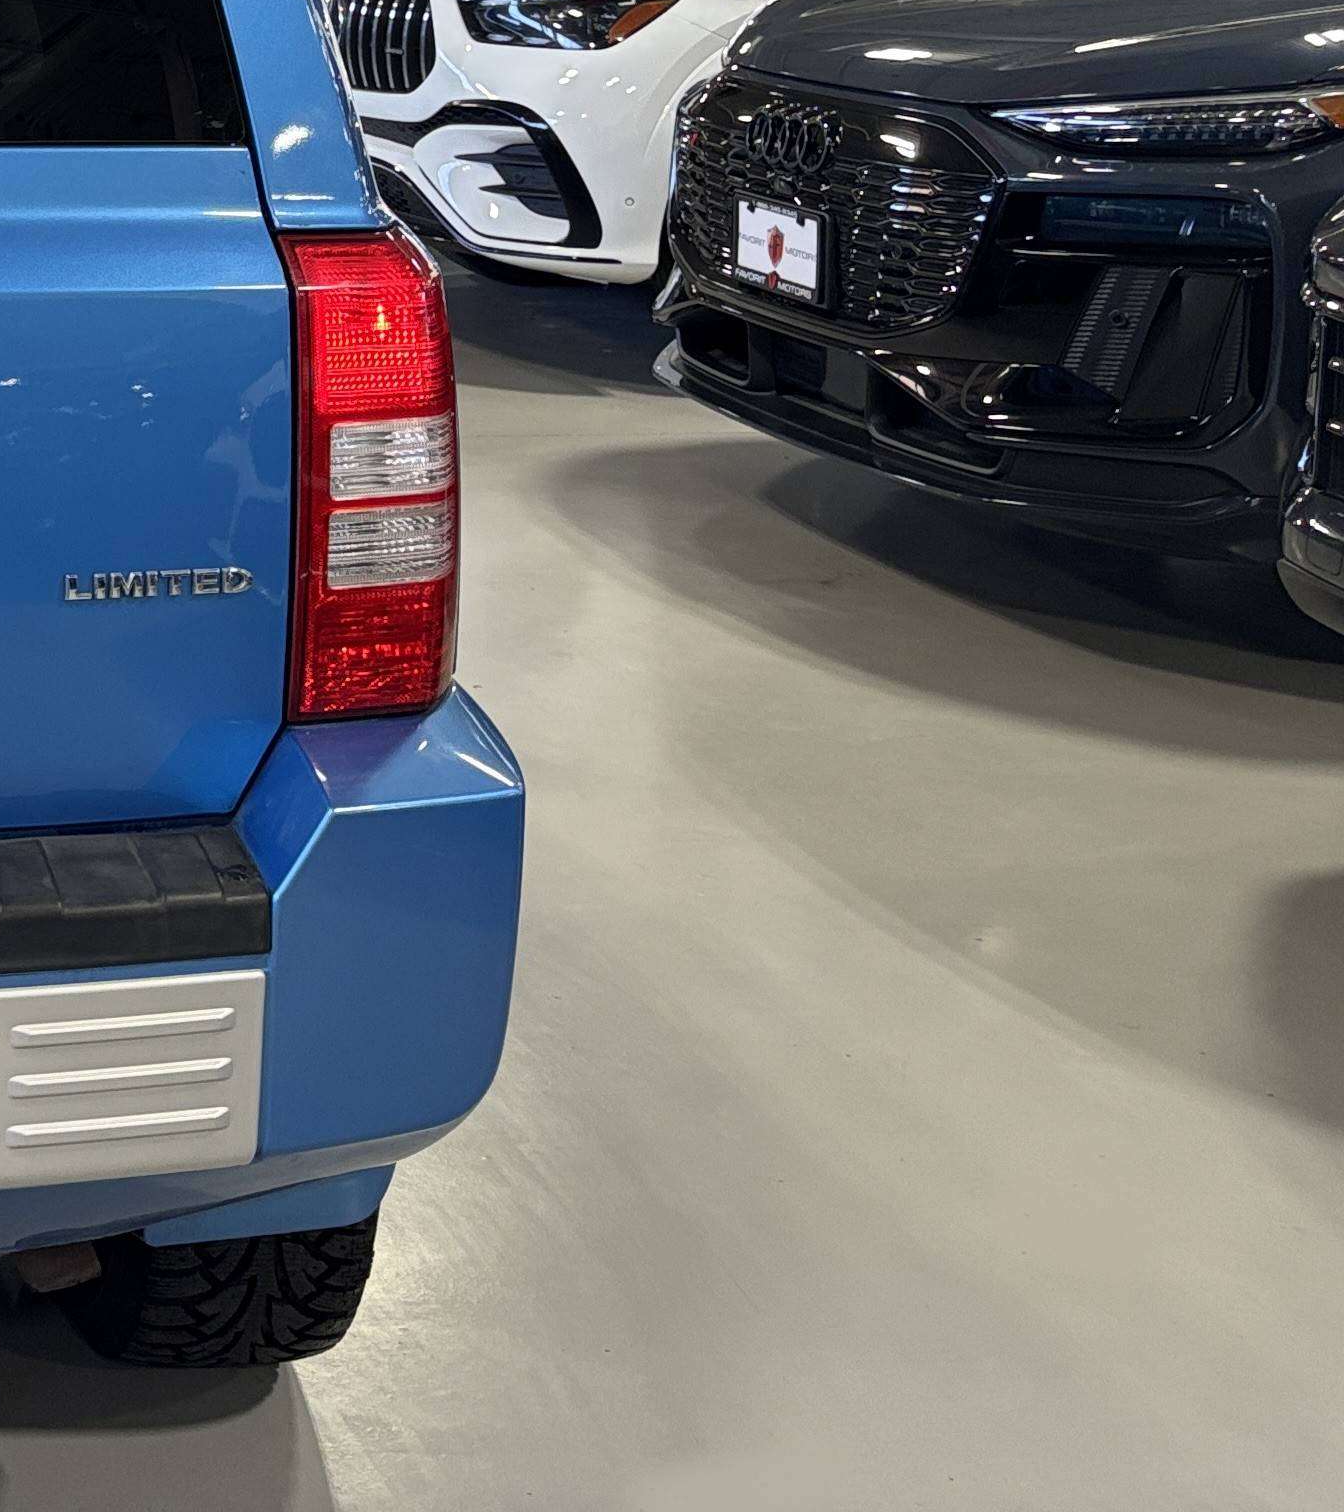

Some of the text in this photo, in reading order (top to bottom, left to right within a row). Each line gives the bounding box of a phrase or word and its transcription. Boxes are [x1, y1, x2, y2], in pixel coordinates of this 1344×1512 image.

[735, 268, 813, 300] FAVORIT MOTORS
[62, 564, 256, 603] LIMITED
